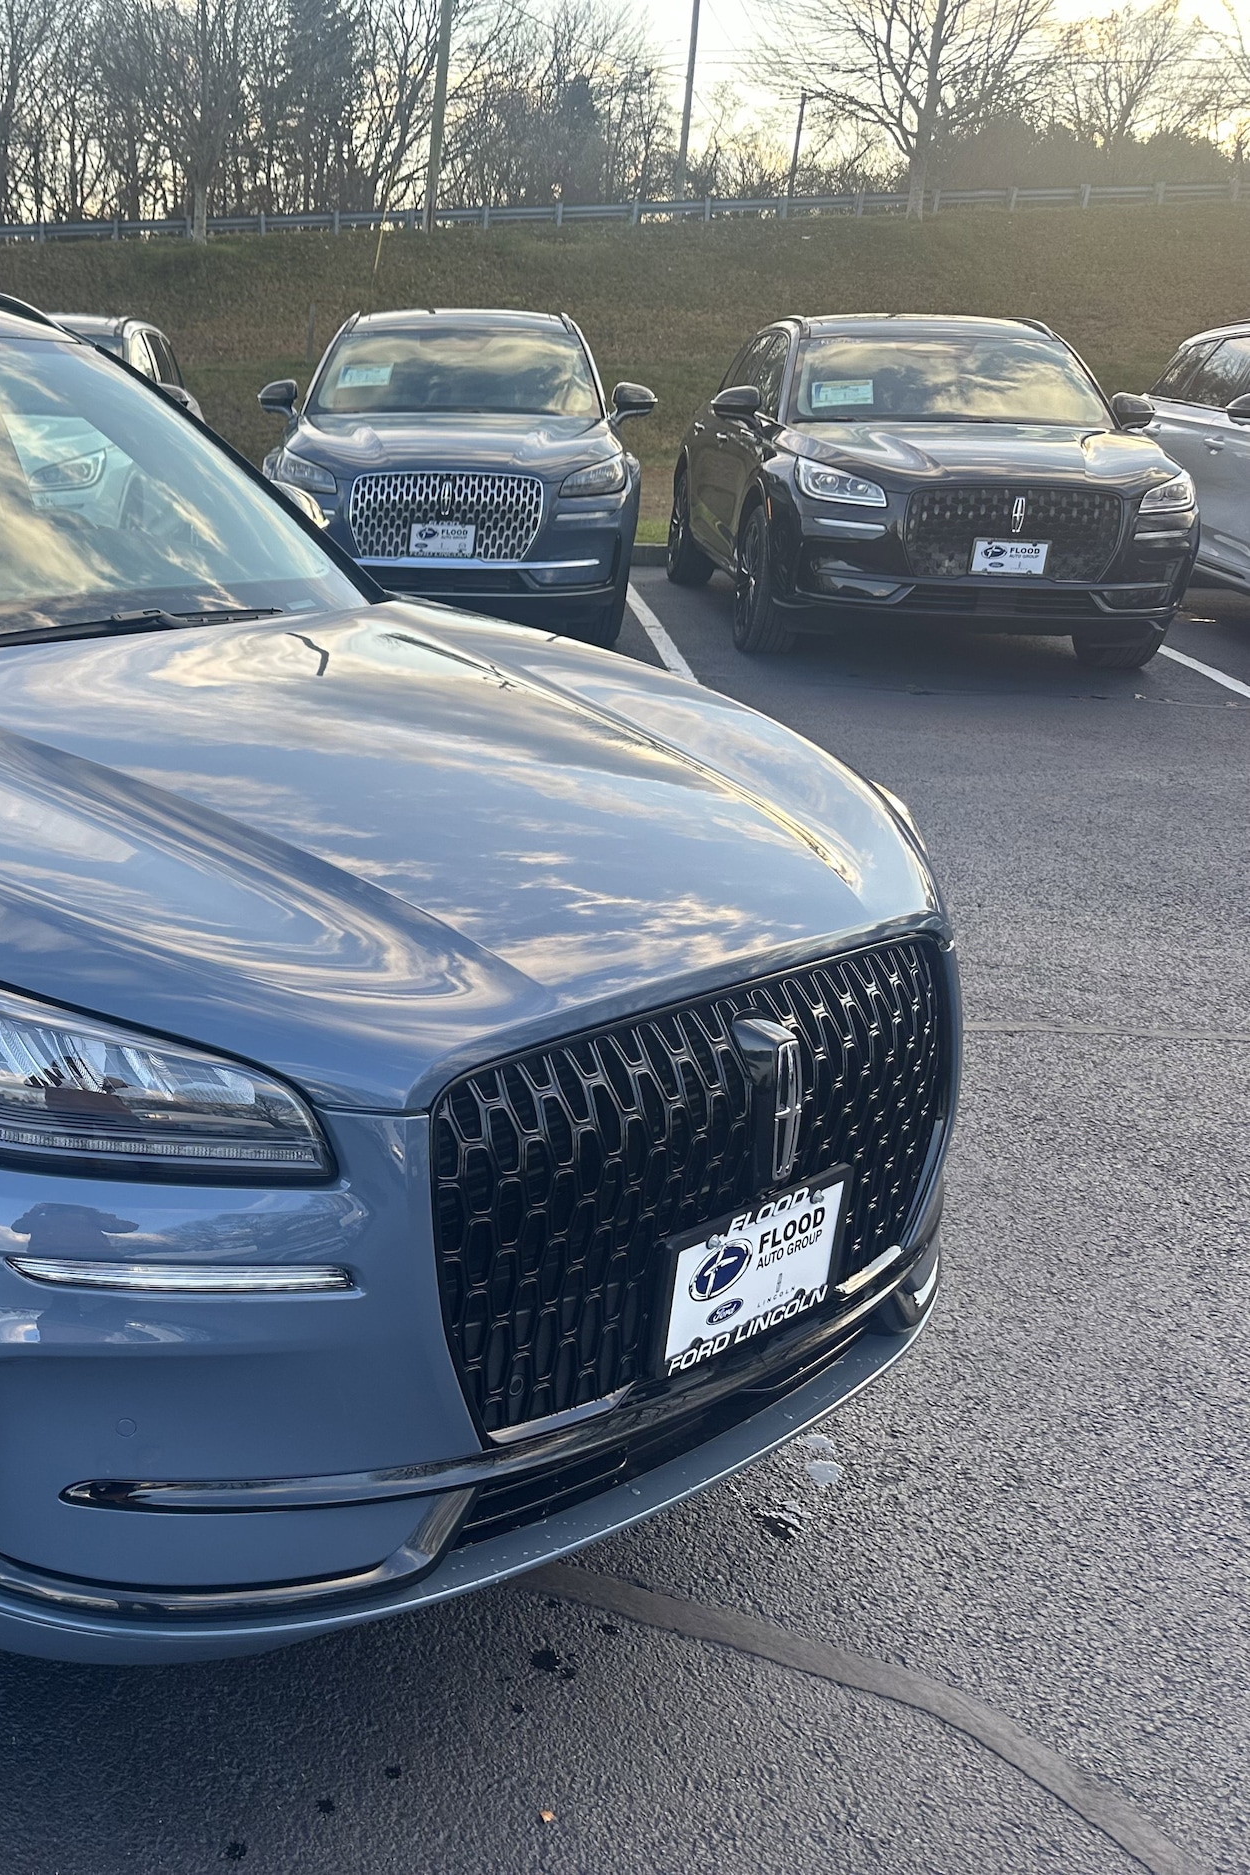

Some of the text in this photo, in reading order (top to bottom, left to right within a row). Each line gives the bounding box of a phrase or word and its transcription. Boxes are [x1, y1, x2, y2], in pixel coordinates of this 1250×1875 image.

[1009, 547, 1041, 555] FLOOD
[727, 1187, 810, 1237] FLOOD
[758, 1206, 825, 1254] FLOOD
[756, 1229, 823, 1271] AUTO GROUP
[712, 1303, 738, 1322] Ford
[757, 1286, 796, 1308] LINCOLN
[668, 1285, 829, 1377] FORD LINCOLN
